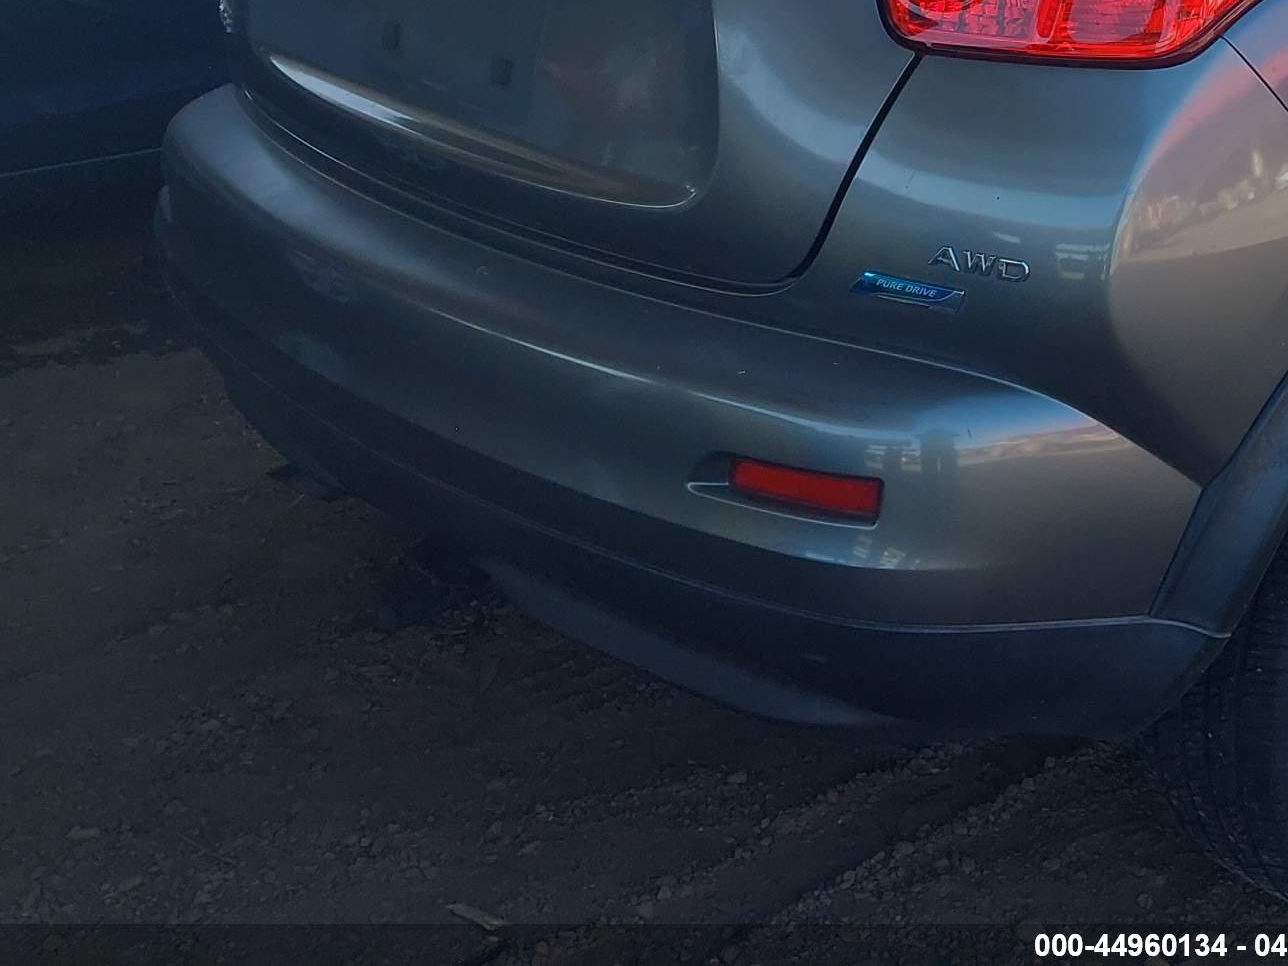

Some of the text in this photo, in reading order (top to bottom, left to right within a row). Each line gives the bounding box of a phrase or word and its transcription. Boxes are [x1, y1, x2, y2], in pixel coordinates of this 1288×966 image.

[928, 245, 1032, 283] AWD
[876, 278, 938, 298] PURE DRIVE
